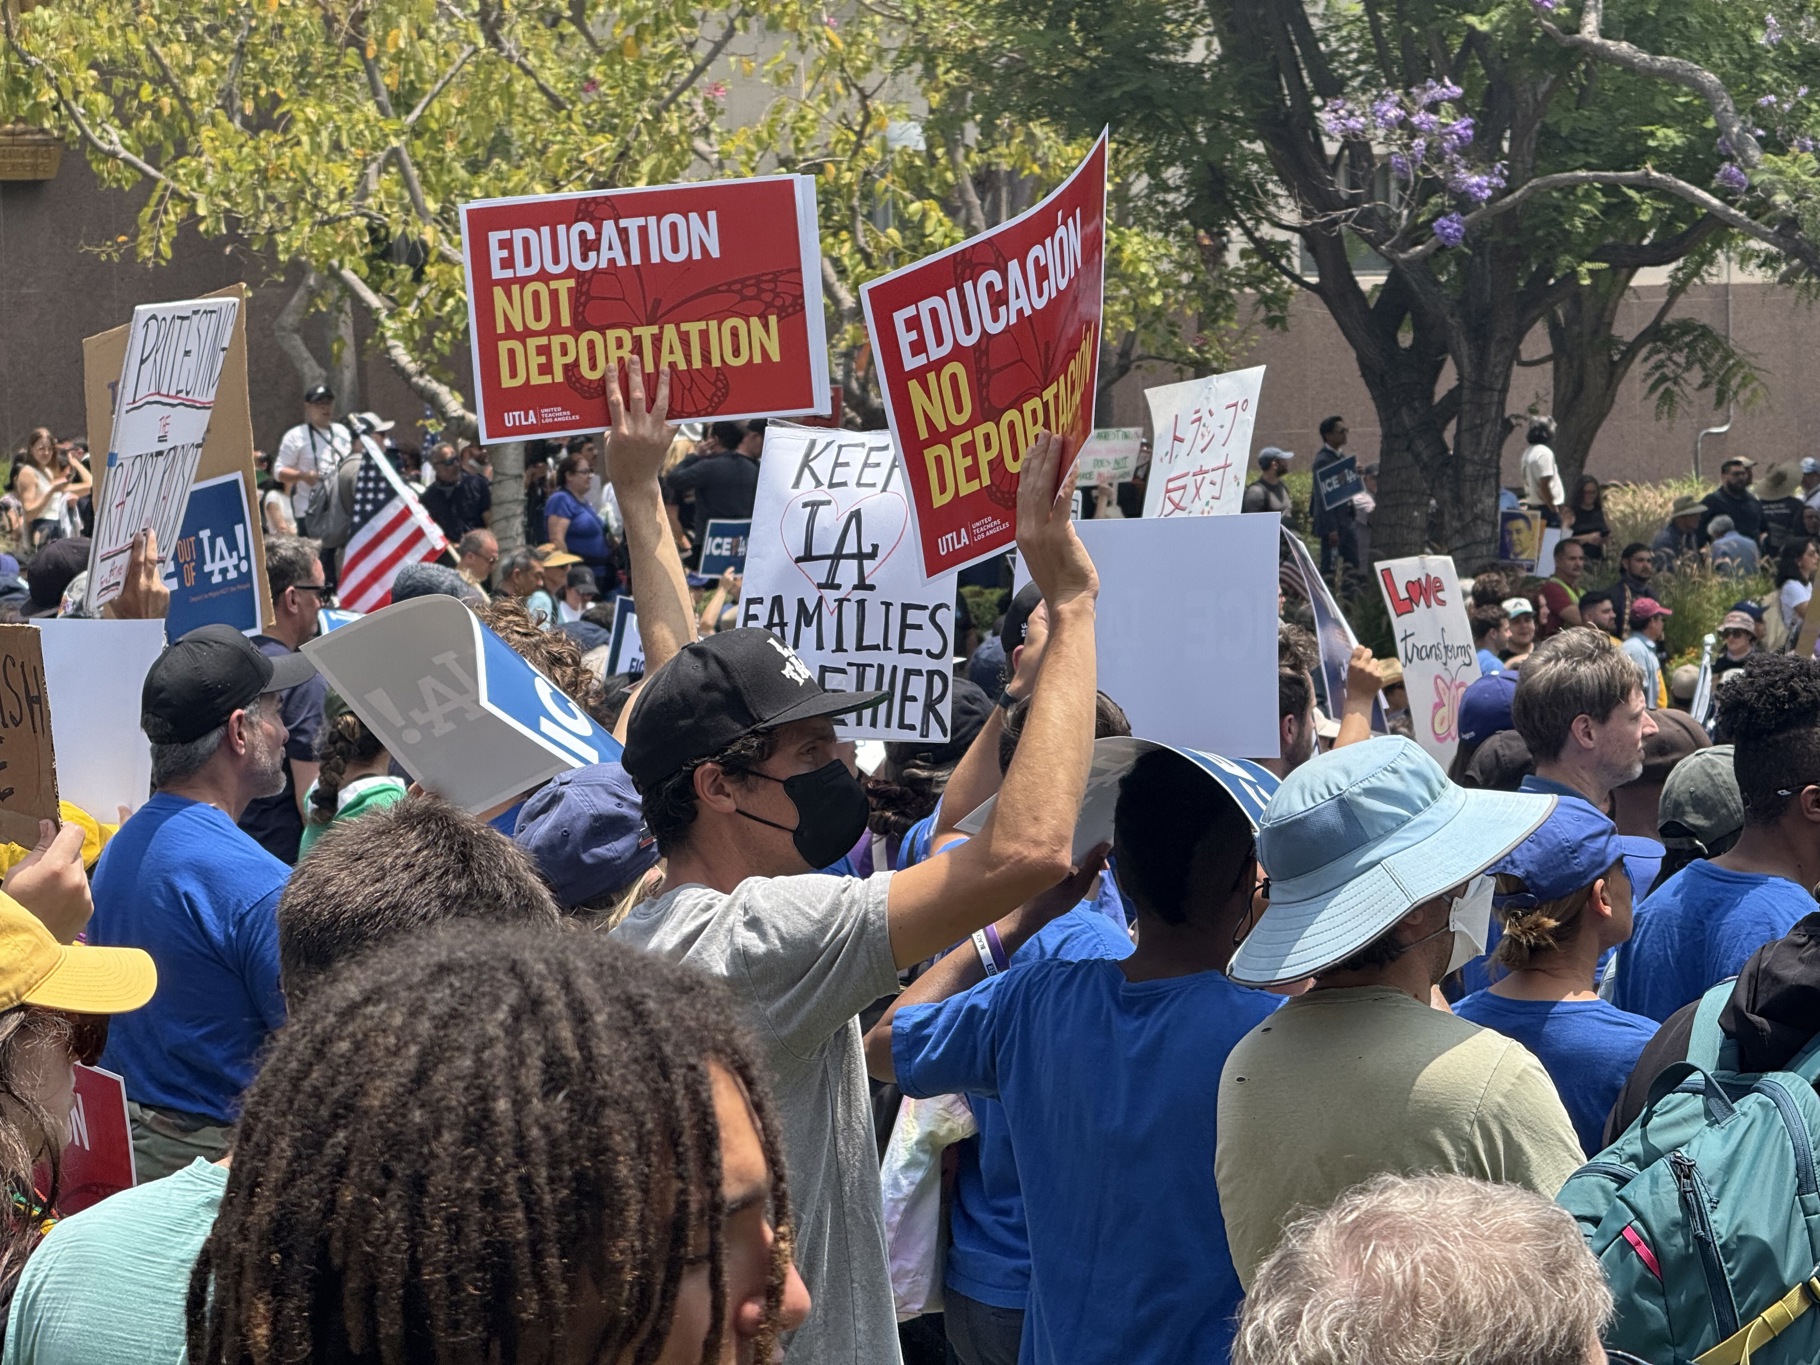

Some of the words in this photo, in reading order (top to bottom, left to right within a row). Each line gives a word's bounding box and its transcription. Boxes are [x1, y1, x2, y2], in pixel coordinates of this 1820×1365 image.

[488, 211, 720, 280] EDUCATION
[492, 279, 576, 334] NOT
[892, 206, 1081, 372] EDUCACIÓN
[133, 302, 236, 403] PROTESTING
[498, 315, 781, 389] DEPORTATION
[504, 410, 537, 428] UTLA
[553, 414, 580, 422] ANGELES
[907, 361, 973, 441] NO
[1169, 398, 1249, 464] トランプ
[1158, 453, 1233, 517] 反対
[177, 536, 196, 563] OUT
[705, 537, 733, 556] ICE
[795, 499, 879, 591] LA
[938, 527, 970, 556] UTLA
[971, 516, 992, 529] UNITED
[972, 518, 1001, 535] TEACHERS
[973, 533, 985, 542] LOS
[985, 521, 1010, 537] ANGELES
[183, 562, 196, 588] OF
[199, 523, 248, 584] LA!
[742, 594, 951, 660] FAMILIES
[0, 654, 45, 739] SH
